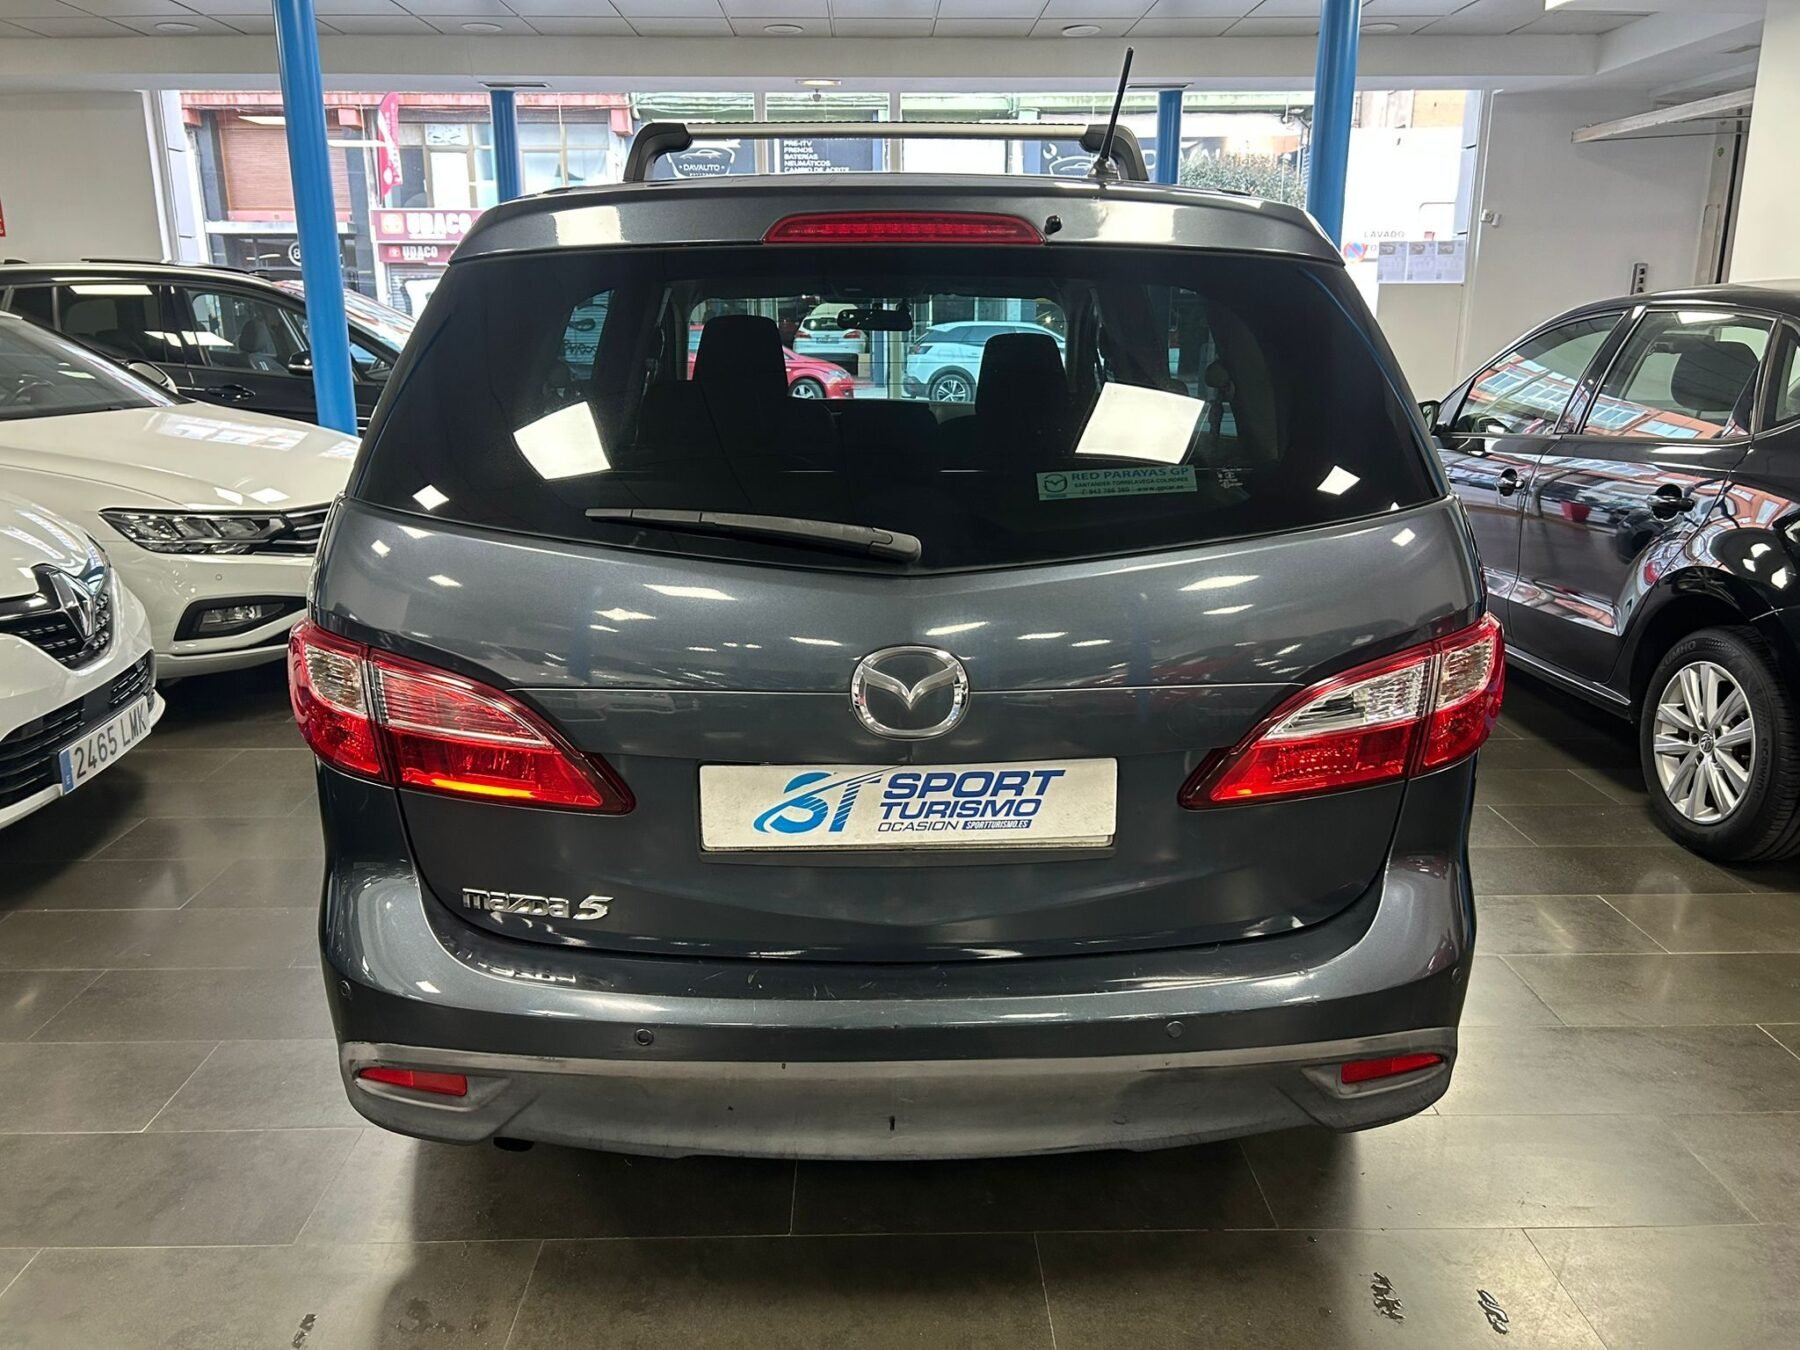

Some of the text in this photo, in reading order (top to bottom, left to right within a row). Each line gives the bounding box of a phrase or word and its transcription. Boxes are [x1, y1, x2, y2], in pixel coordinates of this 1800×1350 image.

[683, 163, 720, 171] DAVAUTO
[1071, 467, 1189, 480] RED PARAYAS GP
[74, 726, 118, 780] 2465
[120, 702, 147, 747] LMK
[883, 769, 1067, 800] SPORT
[879, 798, 1043, 820] TURISMO
[877, 820, 1029, 833] OCASION SPORTTURISMO.ES
[573, 894, 614, 921] 5
